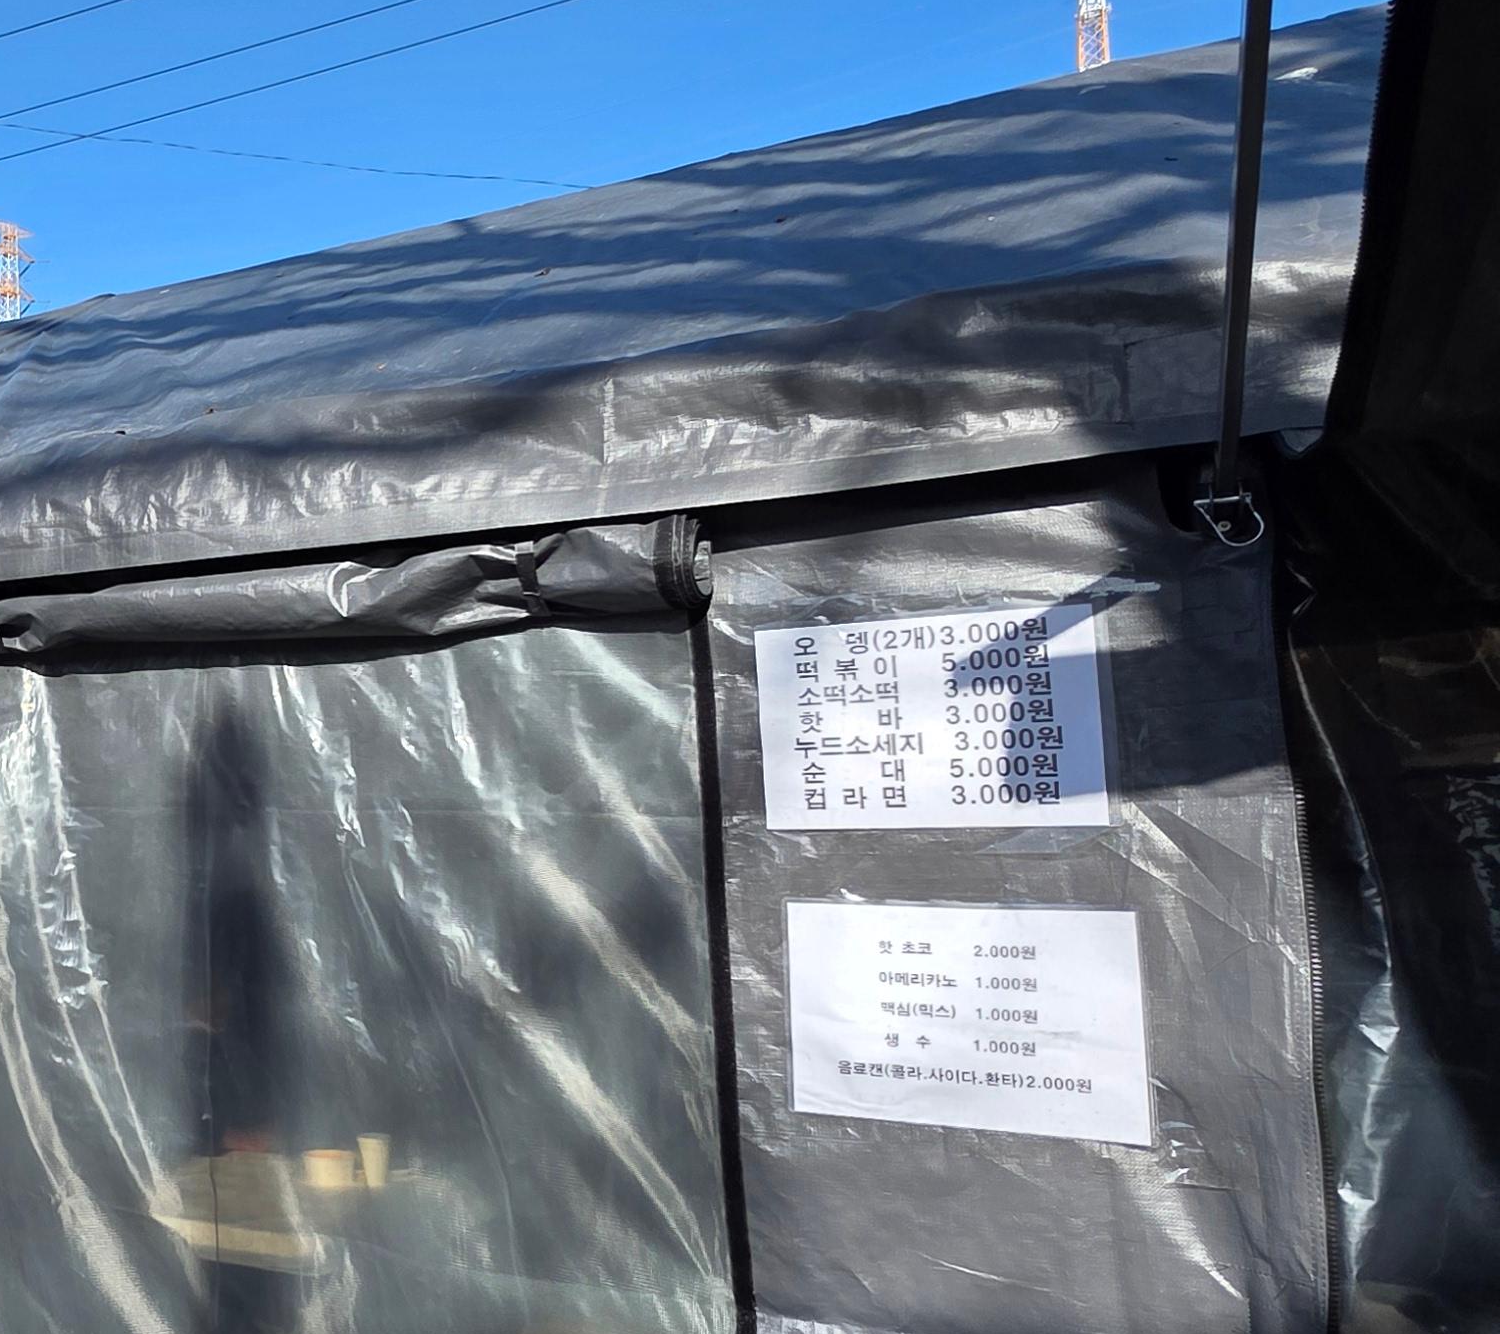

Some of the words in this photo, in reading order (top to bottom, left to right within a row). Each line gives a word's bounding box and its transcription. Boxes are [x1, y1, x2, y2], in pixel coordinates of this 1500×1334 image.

[793, 636, 817, 656] 오
[845, 626, 935, 655] 뎅(2개)
[940, 616, 1048, 646] 3.000원
[797, 662, 818, 682] 떡
[834, 658, 858, 679] 볶
[875, 655, 897, 677] 이
[942, 644, 1049, 672] 5.000원
[798, 682, 900, 706] 소떡소떡
[944, 671, 1051, 699] 3.000원
[800, 711, 824, 733] 핫
[878, 708, 903, 729] 바
[946, 698, 1053, 725] 3.000원
[795, 733, 924, 758] 누드소세지
[955, 725, 1063, 751] 3.000원
[802, 762, 826, 783] 순
[881, 759, 905, 782] 대
[949, 753, 1058, 778] 5.000원
[805, 787, 826, 810] 컵
[843, 786, 866, 809] 라
[883, 785, 907, 808] 면
[951, 781, 1060, 805] 3.000원
[902, 942, 932, 956] 초코
[974, 945, 1036, 960] 2.000원
[879, 972, 957, 988] 아메리카노
[975, 977, 1037, 992] 1.000원
[881, 1001, 956, 1019] 맥심(믹스)
[975, 1008, 1038, 1024] 1.000원
[885, 1033, 899, 1048] 생
[916, 1035, 931, 1048] 수
[973, 1039, 1036, 1056] 1.000원
